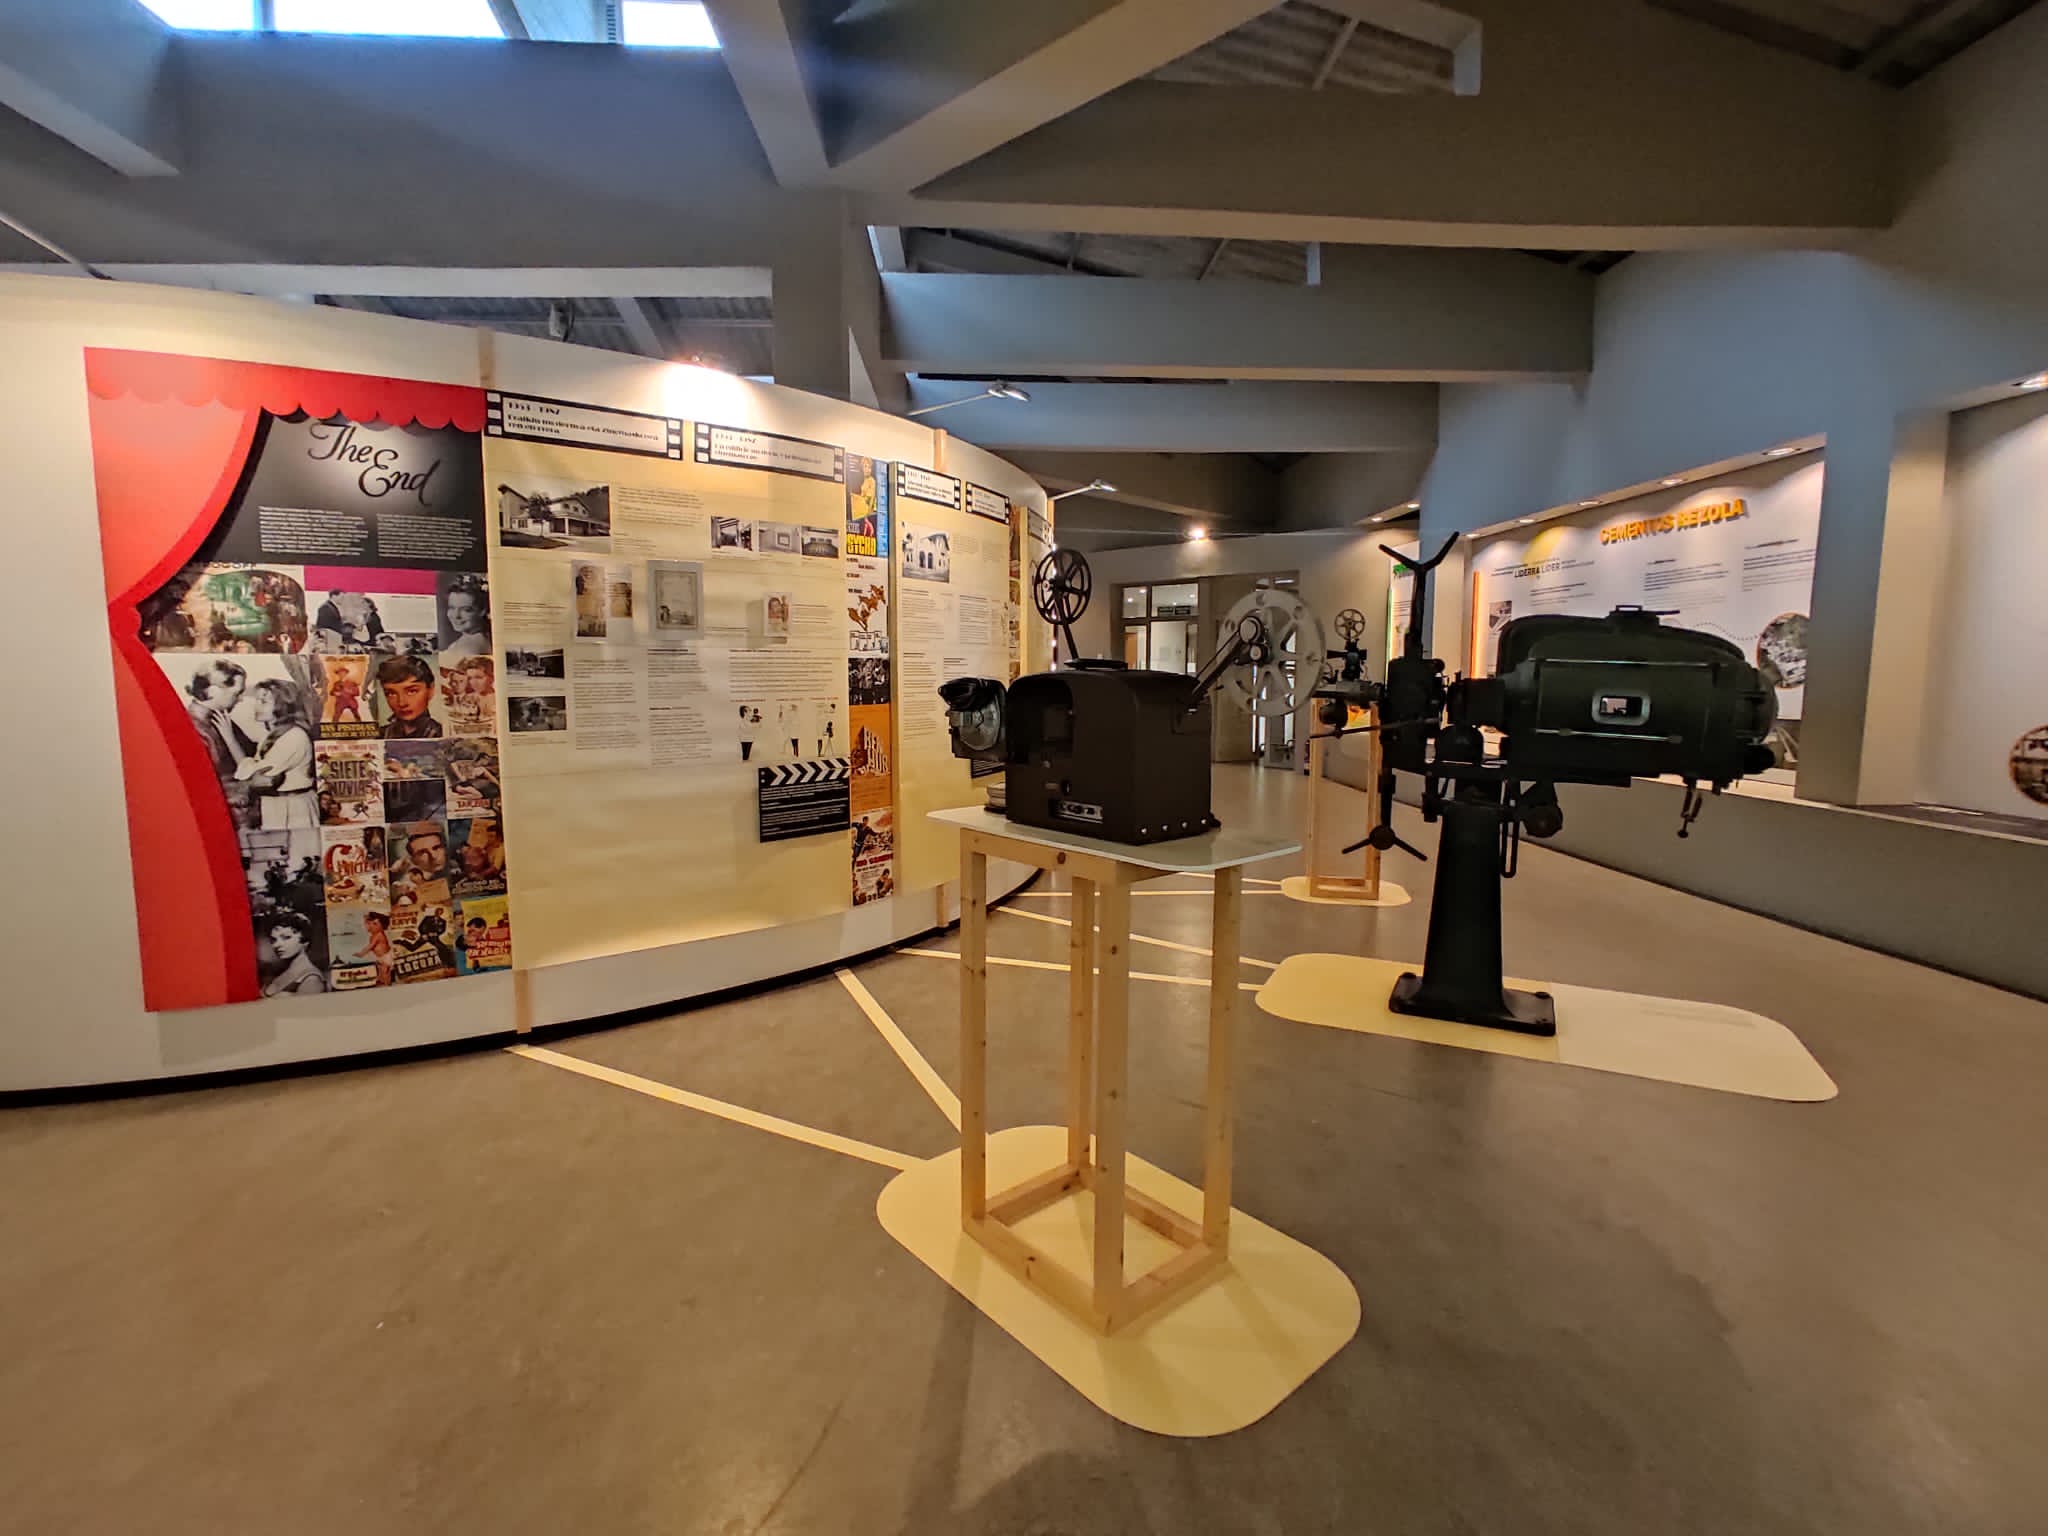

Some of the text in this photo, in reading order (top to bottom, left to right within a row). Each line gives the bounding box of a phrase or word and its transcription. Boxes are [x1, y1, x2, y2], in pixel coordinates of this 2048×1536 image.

[308, 422, 440, 506] The End
[1599, 498, 1744, 544] CEMENTOS REZOLA
[329, 760, 367, 779] SIETE
[398, 955, 441, 974] LOCURA
